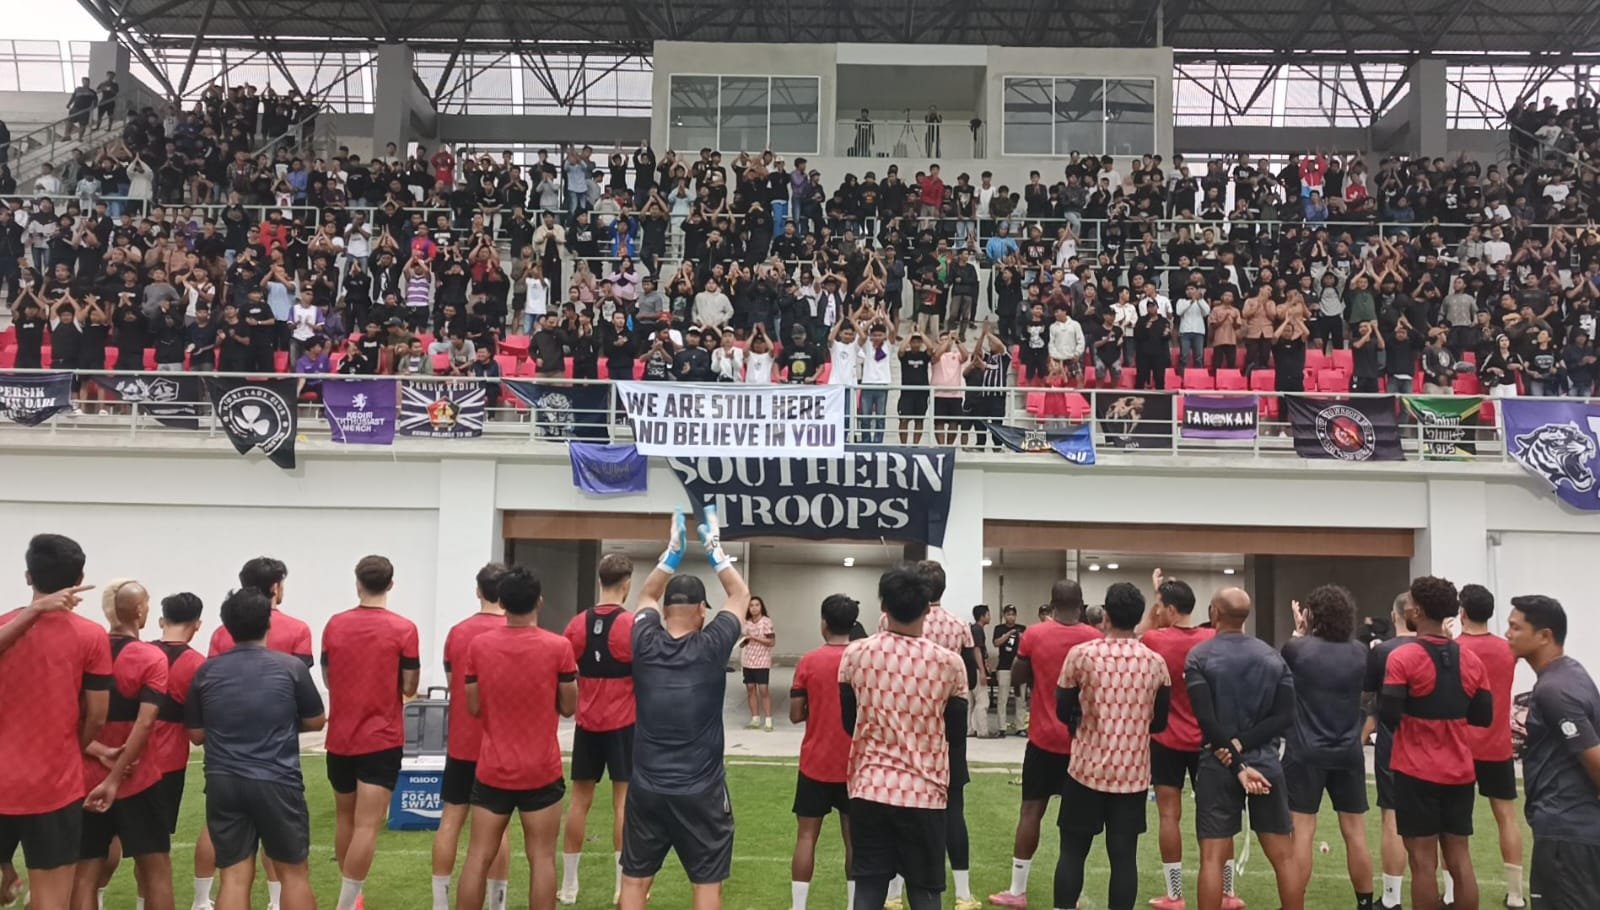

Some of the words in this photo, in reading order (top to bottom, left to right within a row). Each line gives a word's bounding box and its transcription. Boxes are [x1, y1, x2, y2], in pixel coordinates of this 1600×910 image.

[0, 386, 45, 398] PERSIK
[447, 381, 481, 391] KEDIRI
[270, 396, 286, 415] CLUB
[626, 392, 659, 417] WE
[664, 393, 705, 419] ARE
[711, 394, 766, 420] STILL
[772, 395, 826, 420] HERE
[673, 422, 759, 446] BELIEVE
[765, 423, 785, 447] IN
[792, 423, 836, 447] YOU
[668, 452, 944, 492] SOUTHERN
[704, 493, 909, 529] TROOPS
